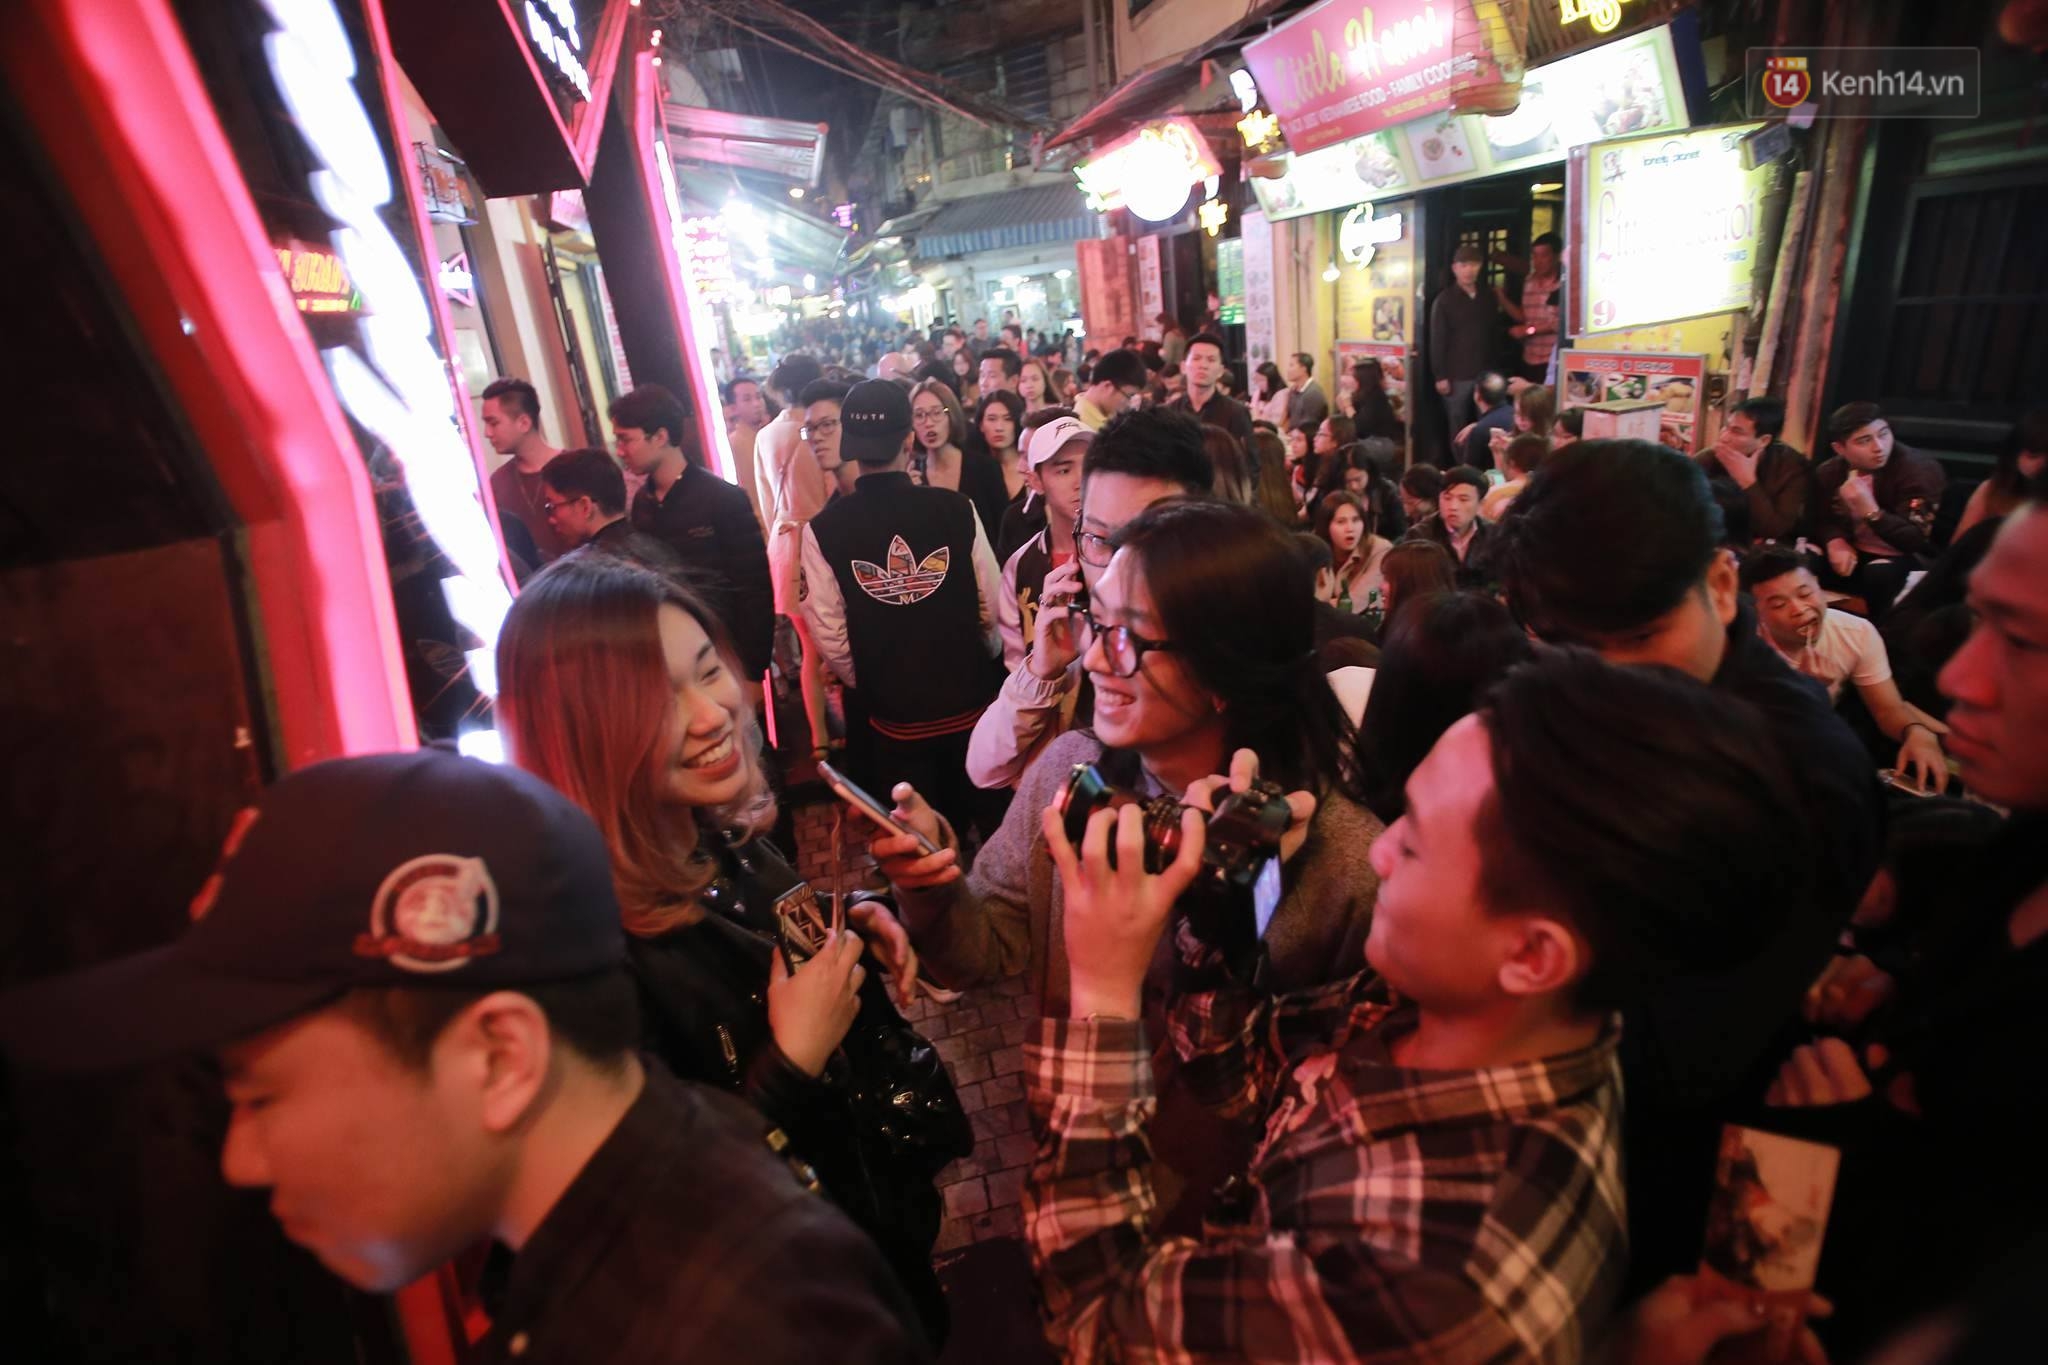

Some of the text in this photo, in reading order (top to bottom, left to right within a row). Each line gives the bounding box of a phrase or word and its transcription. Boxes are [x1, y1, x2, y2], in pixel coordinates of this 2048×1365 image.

[1273, 29, 1347, 111] Little
[1344, 5, 1445, 80] Hanoi
[1359, 87, 1386, 107] FOOD
[1388, 71, 1424, 98] FAMILY
[1593, 300, 1616, 326] 9
[1585, 359, 1619, 371] FOOD
[1634, 361, 1675, 373] DRINK
[849, 412, 886, 422] YOUTH
